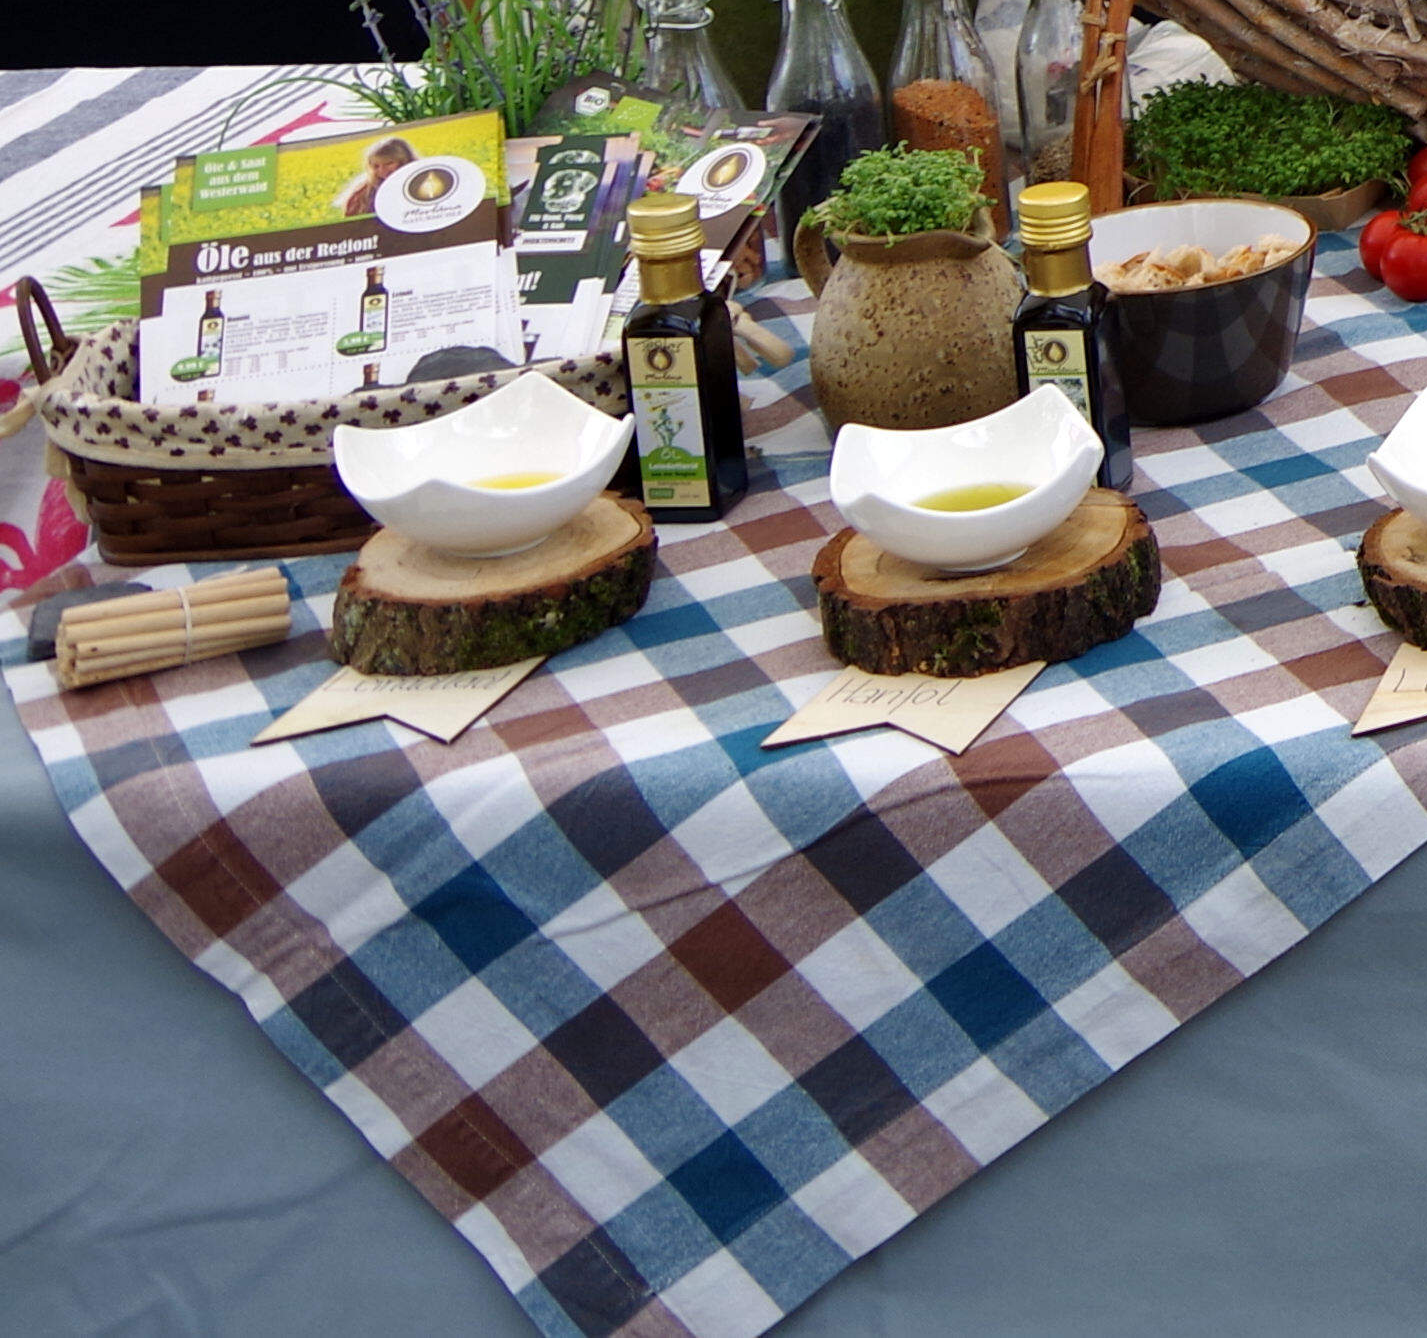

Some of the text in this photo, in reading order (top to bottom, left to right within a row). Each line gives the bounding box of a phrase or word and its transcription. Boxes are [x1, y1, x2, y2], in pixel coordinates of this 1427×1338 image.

[196, 235, 379, 274] Öle aus der Region!
